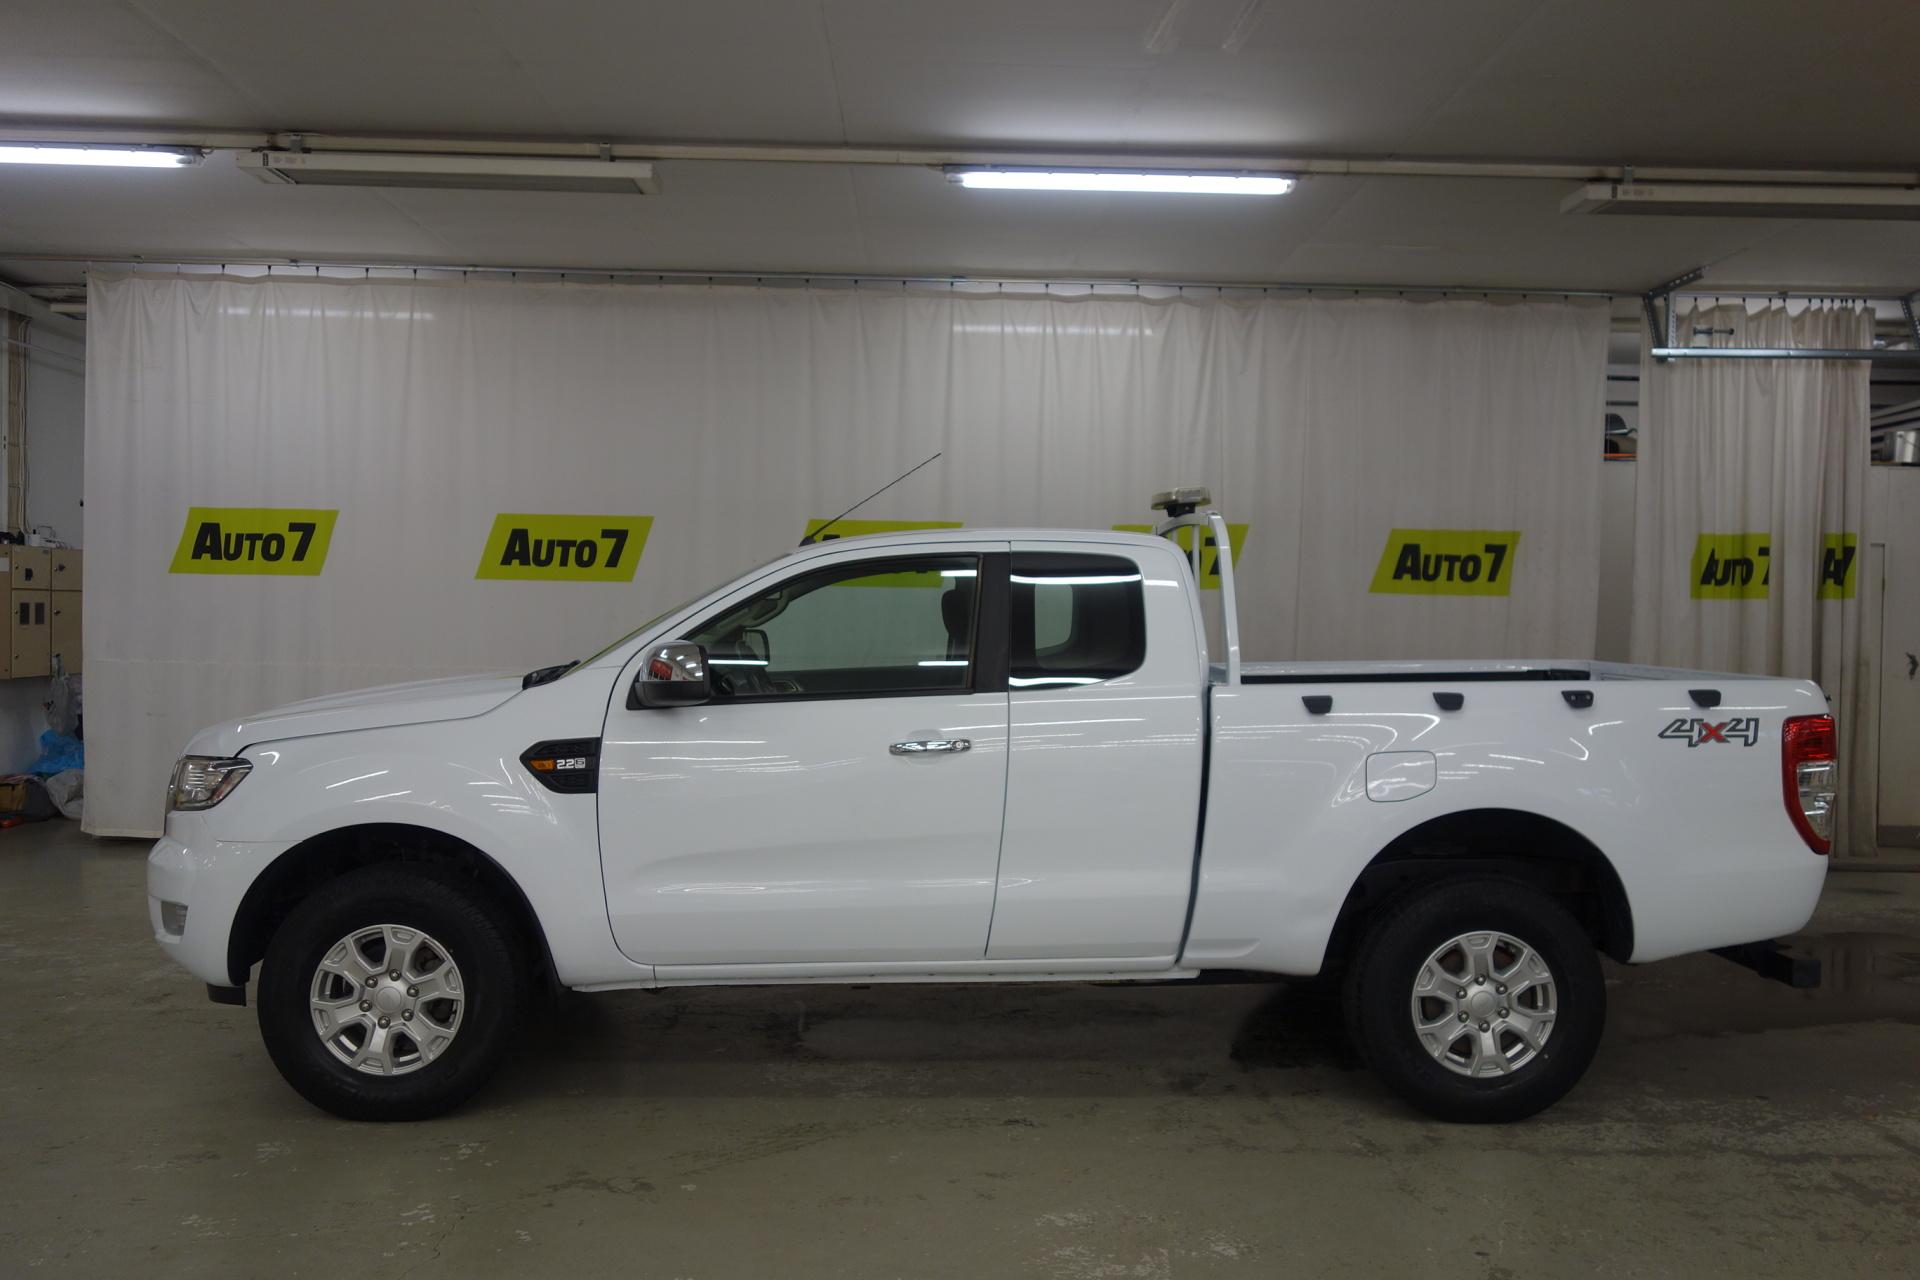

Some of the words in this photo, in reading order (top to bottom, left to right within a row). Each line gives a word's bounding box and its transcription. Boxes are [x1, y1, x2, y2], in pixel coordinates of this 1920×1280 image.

[191, 522, 316, 562] AUTO7
[500, 528, 629, 568] AUTO7
[1392, 543, 1508, 583] AUTO7
